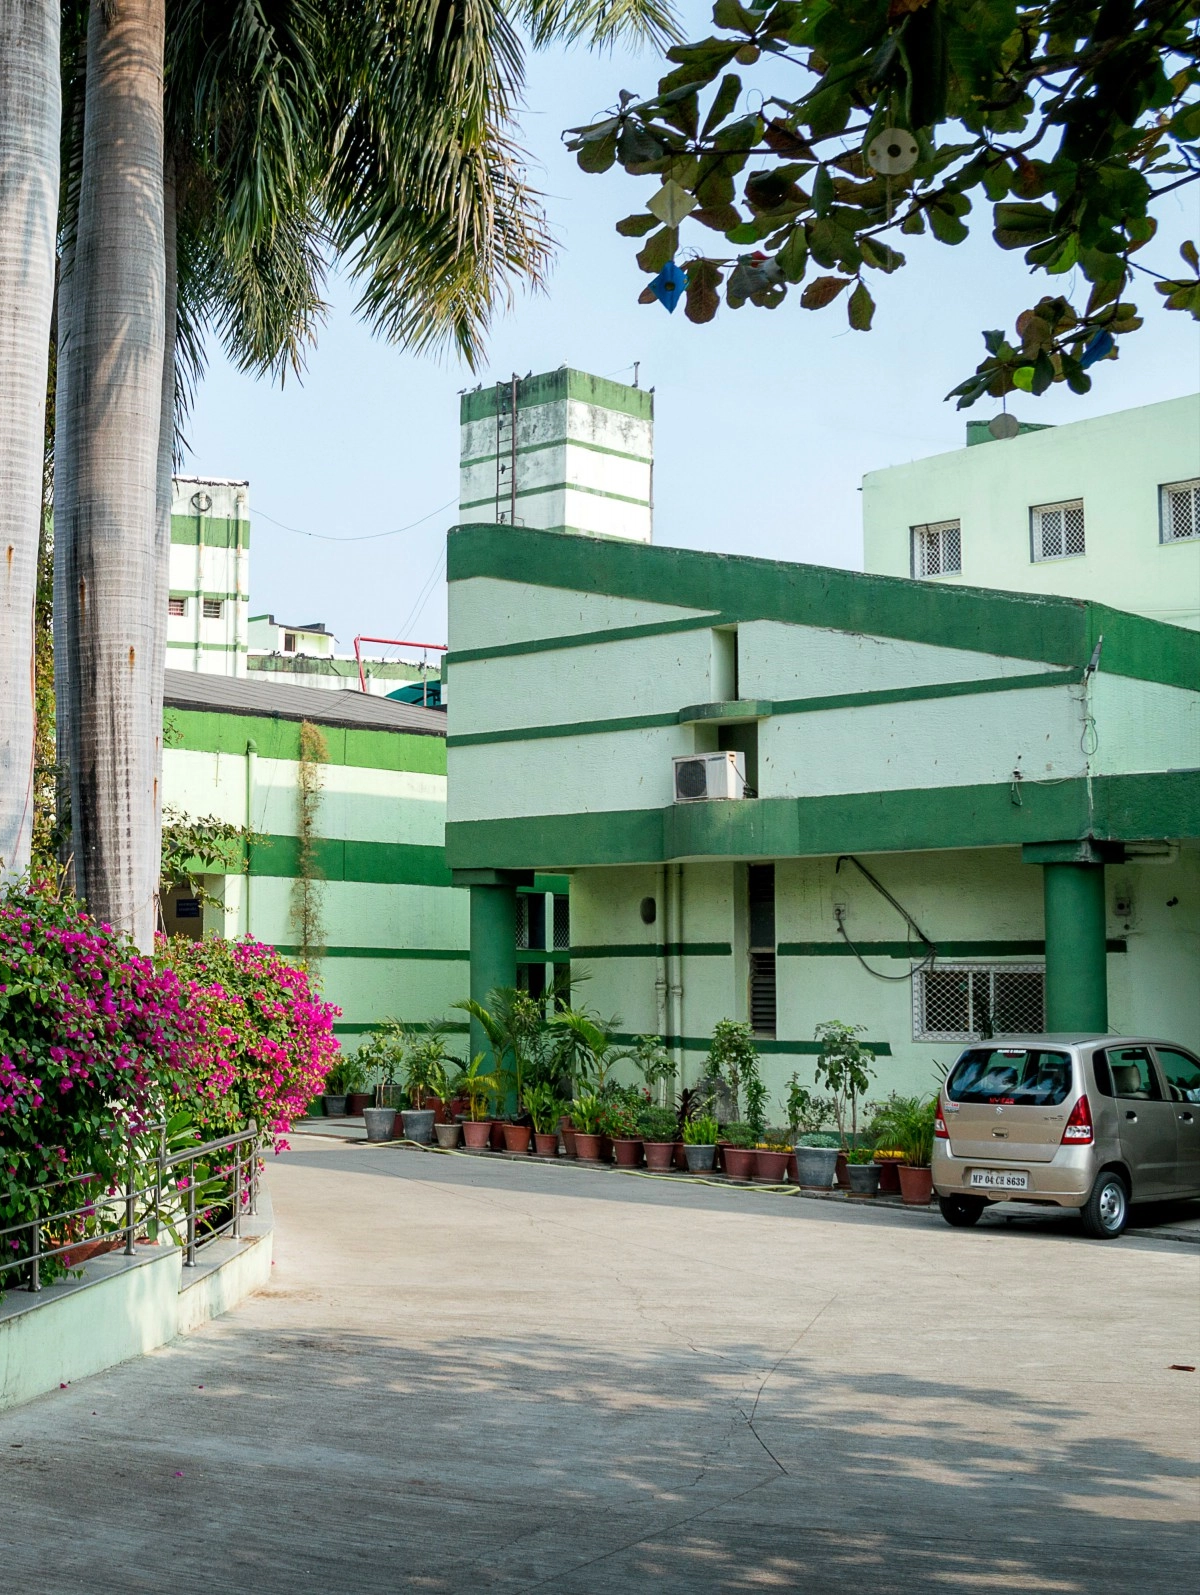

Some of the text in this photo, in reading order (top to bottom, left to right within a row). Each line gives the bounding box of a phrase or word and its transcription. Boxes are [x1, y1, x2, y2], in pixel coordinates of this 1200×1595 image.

[972, 1175, 983, 1184] MP
[984, 1175, 995, 1185] 04
[1006, 1177, 1026, 1187] 8639
